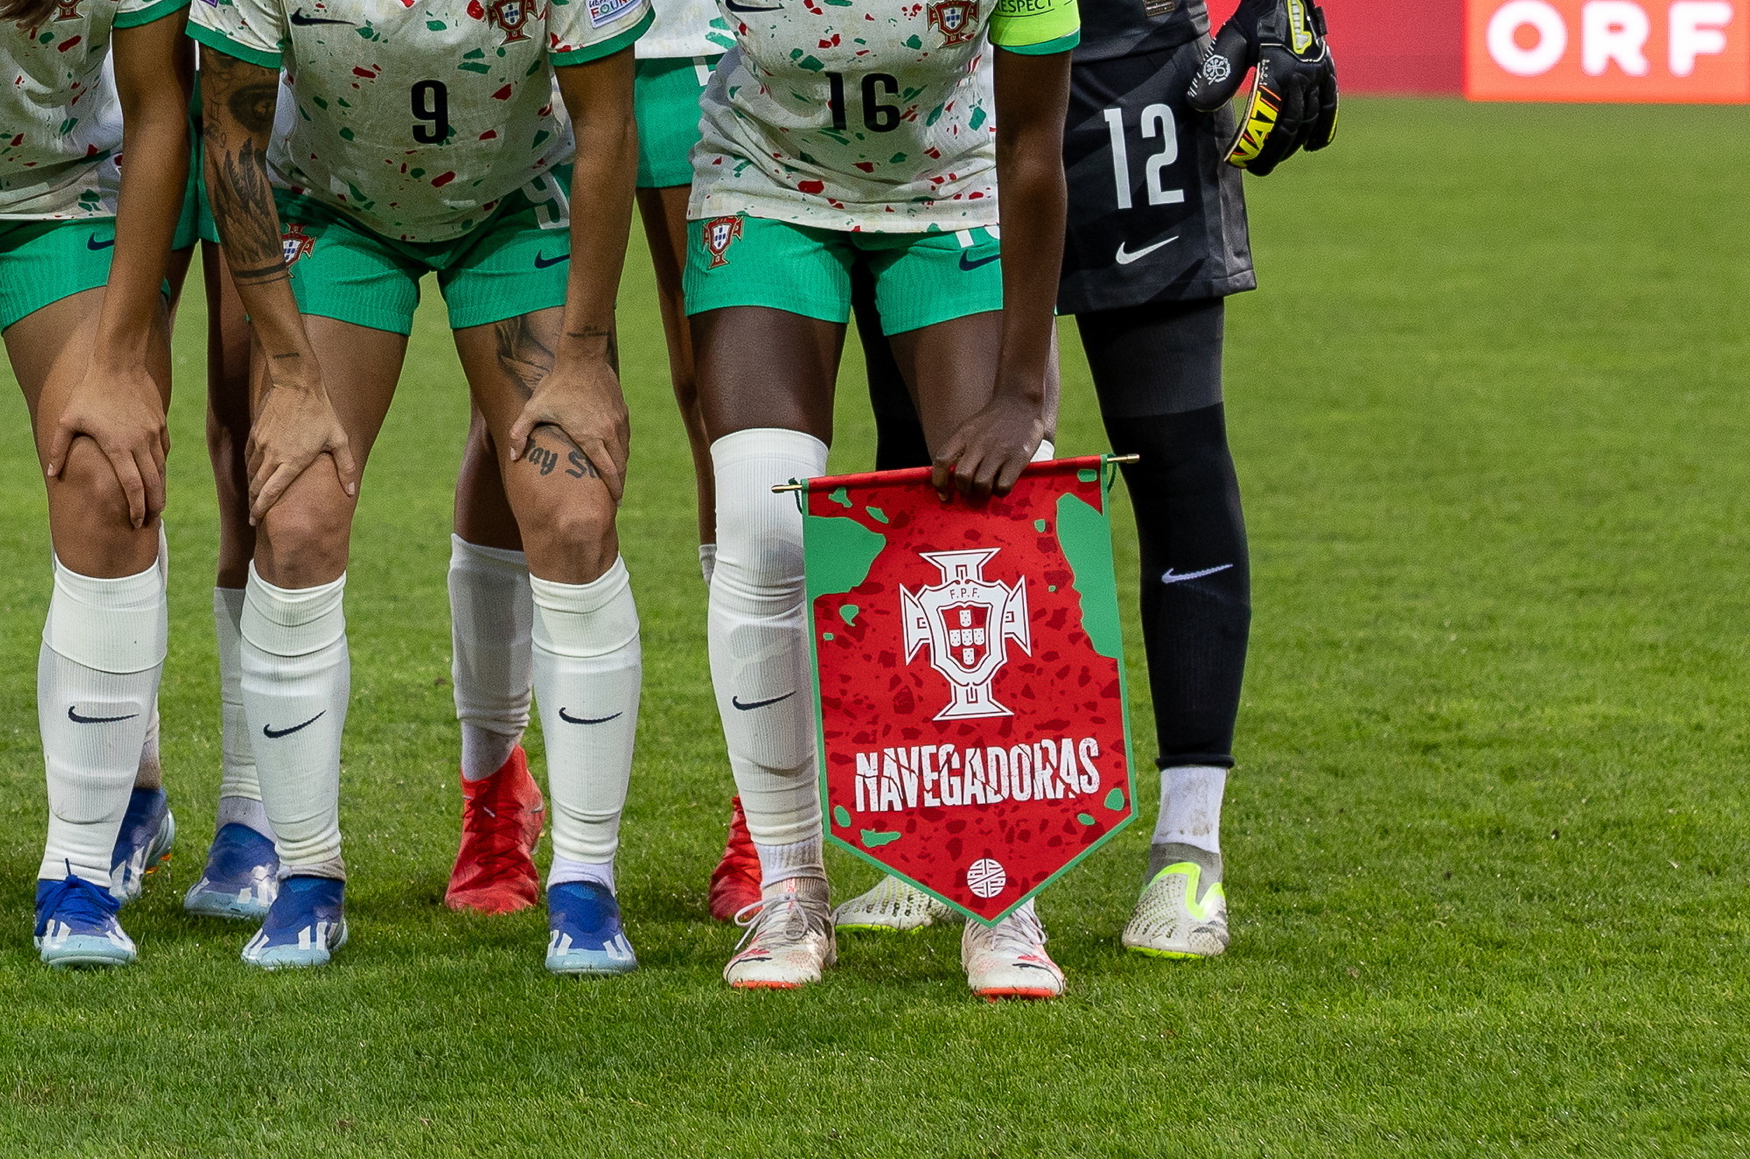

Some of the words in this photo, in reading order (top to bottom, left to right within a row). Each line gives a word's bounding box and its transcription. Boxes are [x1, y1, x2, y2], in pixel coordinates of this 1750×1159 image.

[410, 80, 449, 144] 9
[825, 71, 901, 132] 16
[1103, 103, 1184, 209] 12
[855, 737, 1100, 812] NAVEGADORAS
